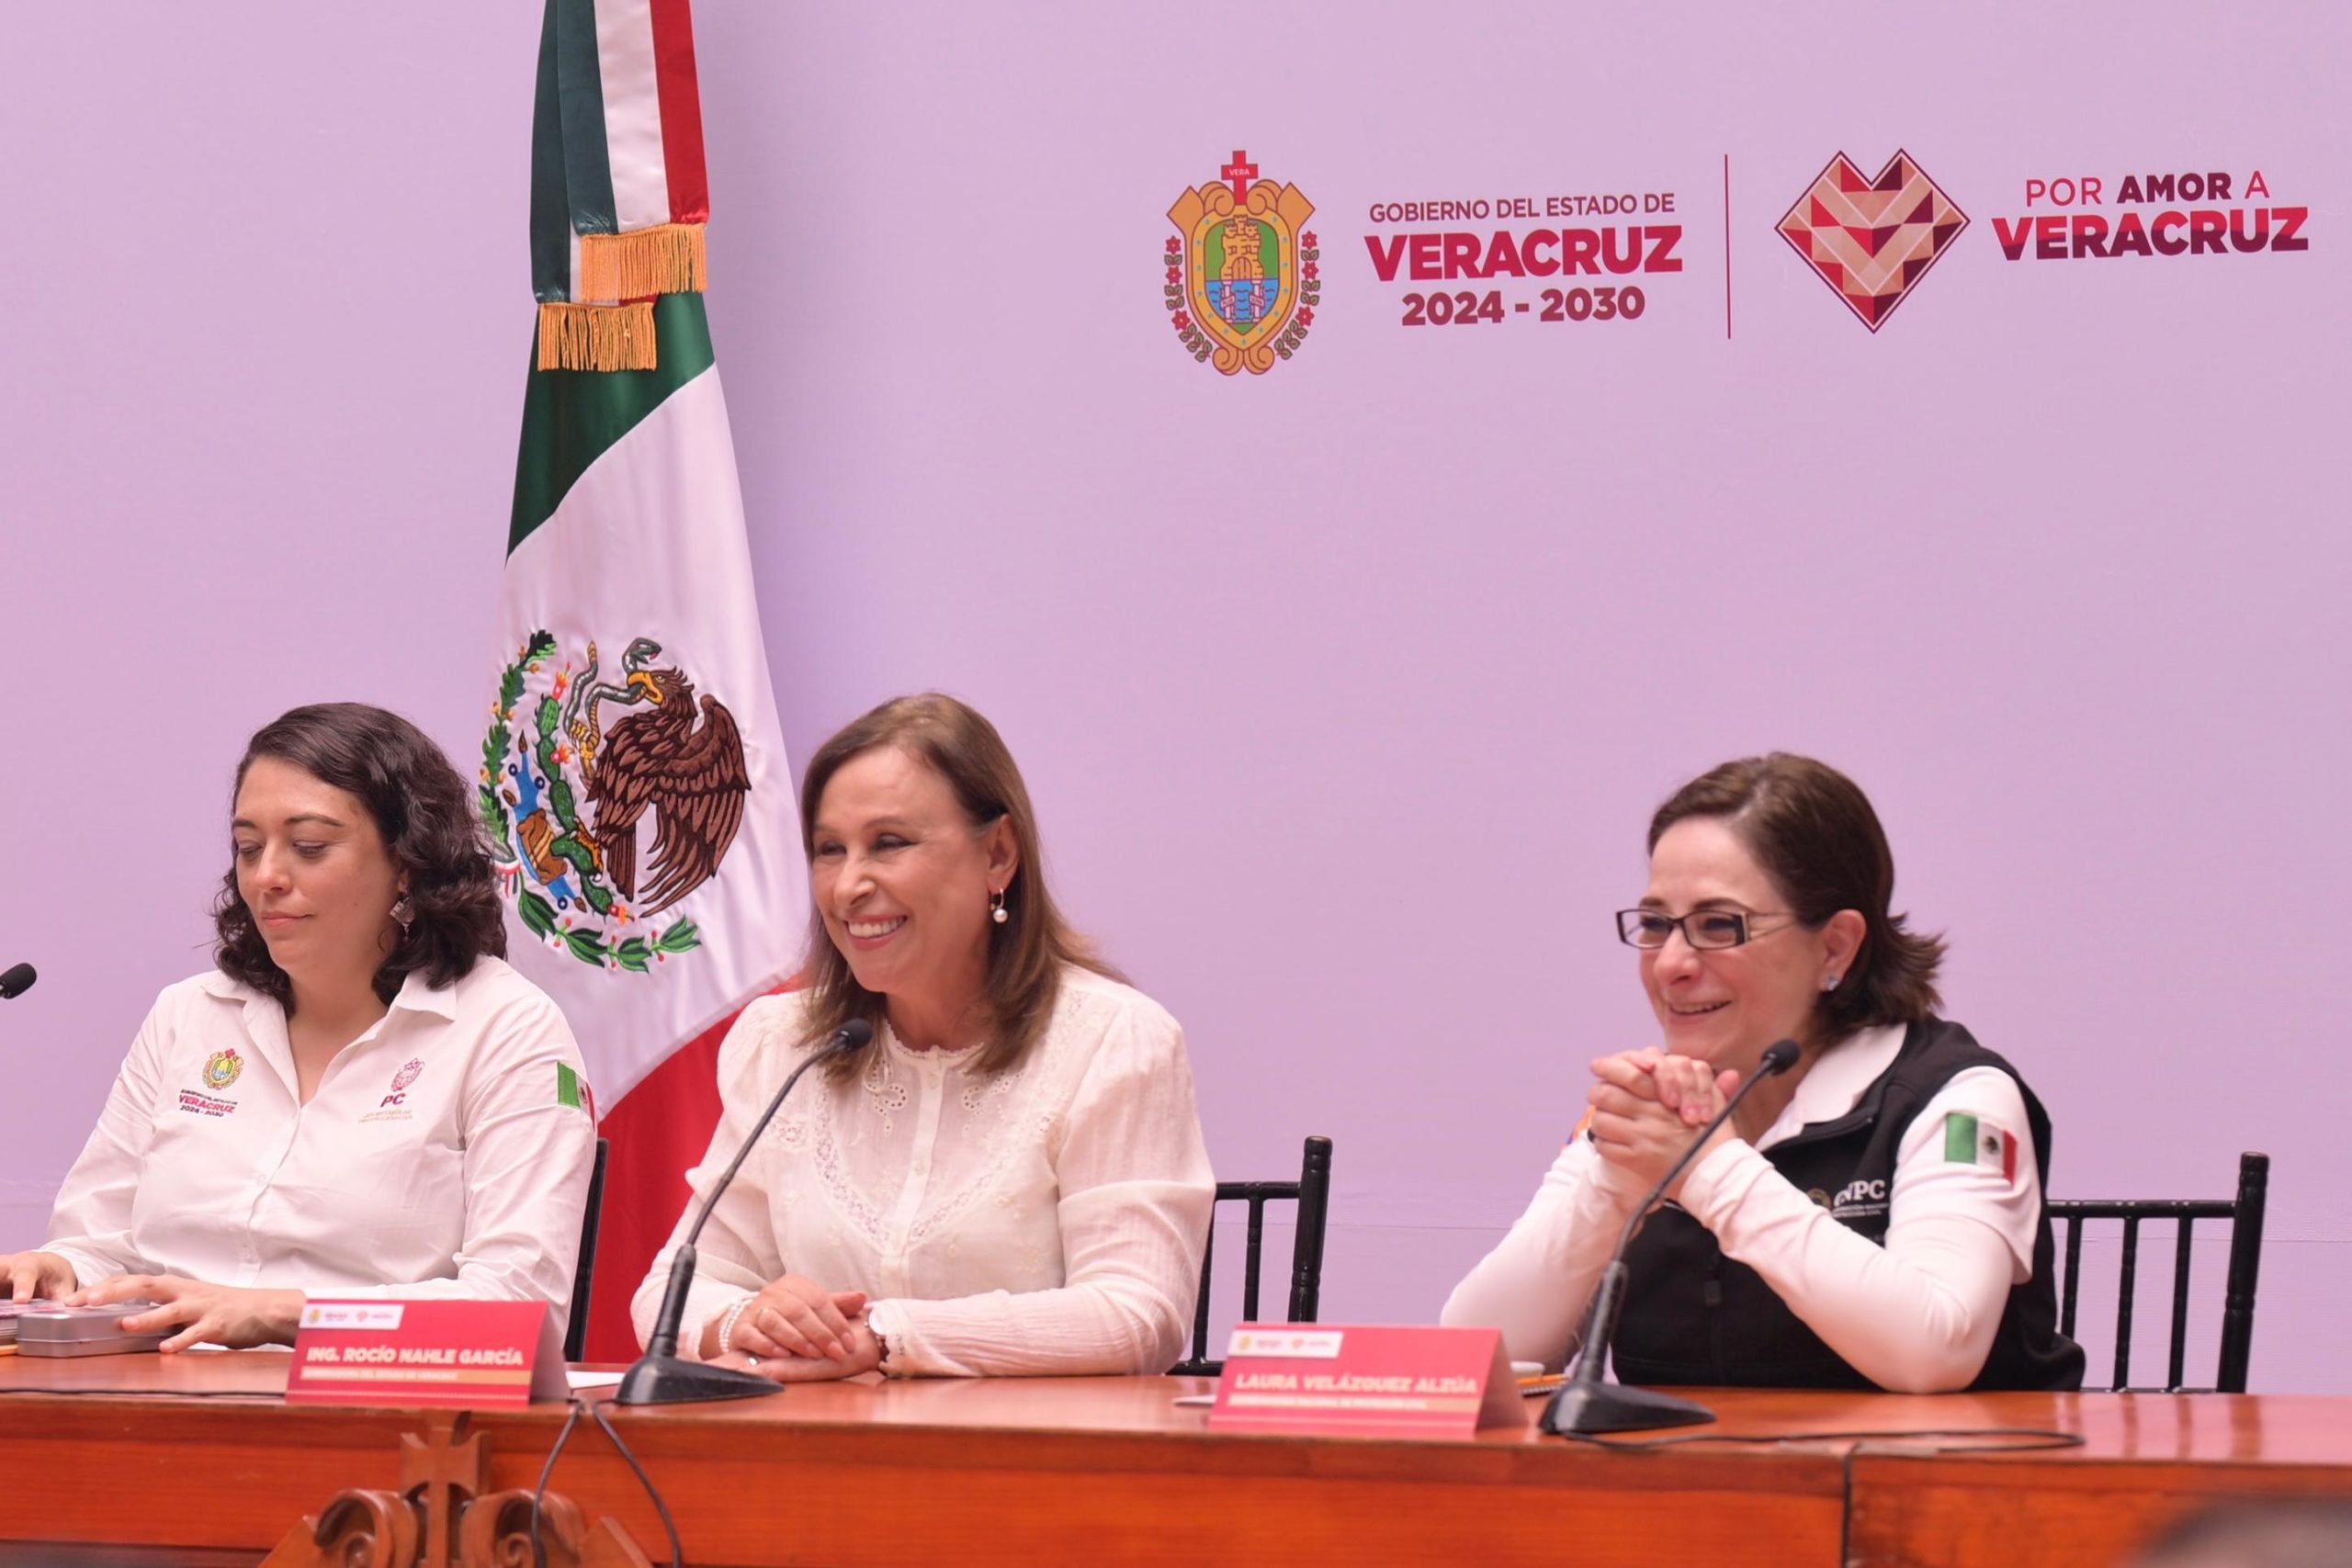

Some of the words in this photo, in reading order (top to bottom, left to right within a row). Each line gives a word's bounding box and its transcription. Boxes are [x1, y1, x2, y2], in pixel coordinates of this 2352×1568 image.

[2026, 177, 2102, 208] POR
[2116, 173, 2232, 204] AMOR
[2245, 170, 2270, 199] A
[1369, 199, 1490, 222] GOBIERNO
[1497, 197, 1540, 219] DEL
[1546, 196, 1637, 217] ESTADO
[1645, 193, 1675, 213] DE
[1991, 207, 2309, 261] VERACRUZ
[1363, 225, 1683, 282] VERACRUZ
[1402, 290, 1505, 326] 2024
[1515, 303, 1530, 312] -
[1540, 286, 1645, 321] 2030
[179, 1094, 235, 1113] VERACRUZ
[380, 1093, 406, 1108] PC
[307, 1347, 339, 1362] ING.
[343, 1345, 396, 1363] ROCÍO
[399, 1348, 458, 1365] NAHLE
[458, 1347, 524, 1366] GARCÍA
[1236, 1373, 1297, 1391] LAURA
[1304, 1371, 1412, 1393] VELÁZQUEZ
